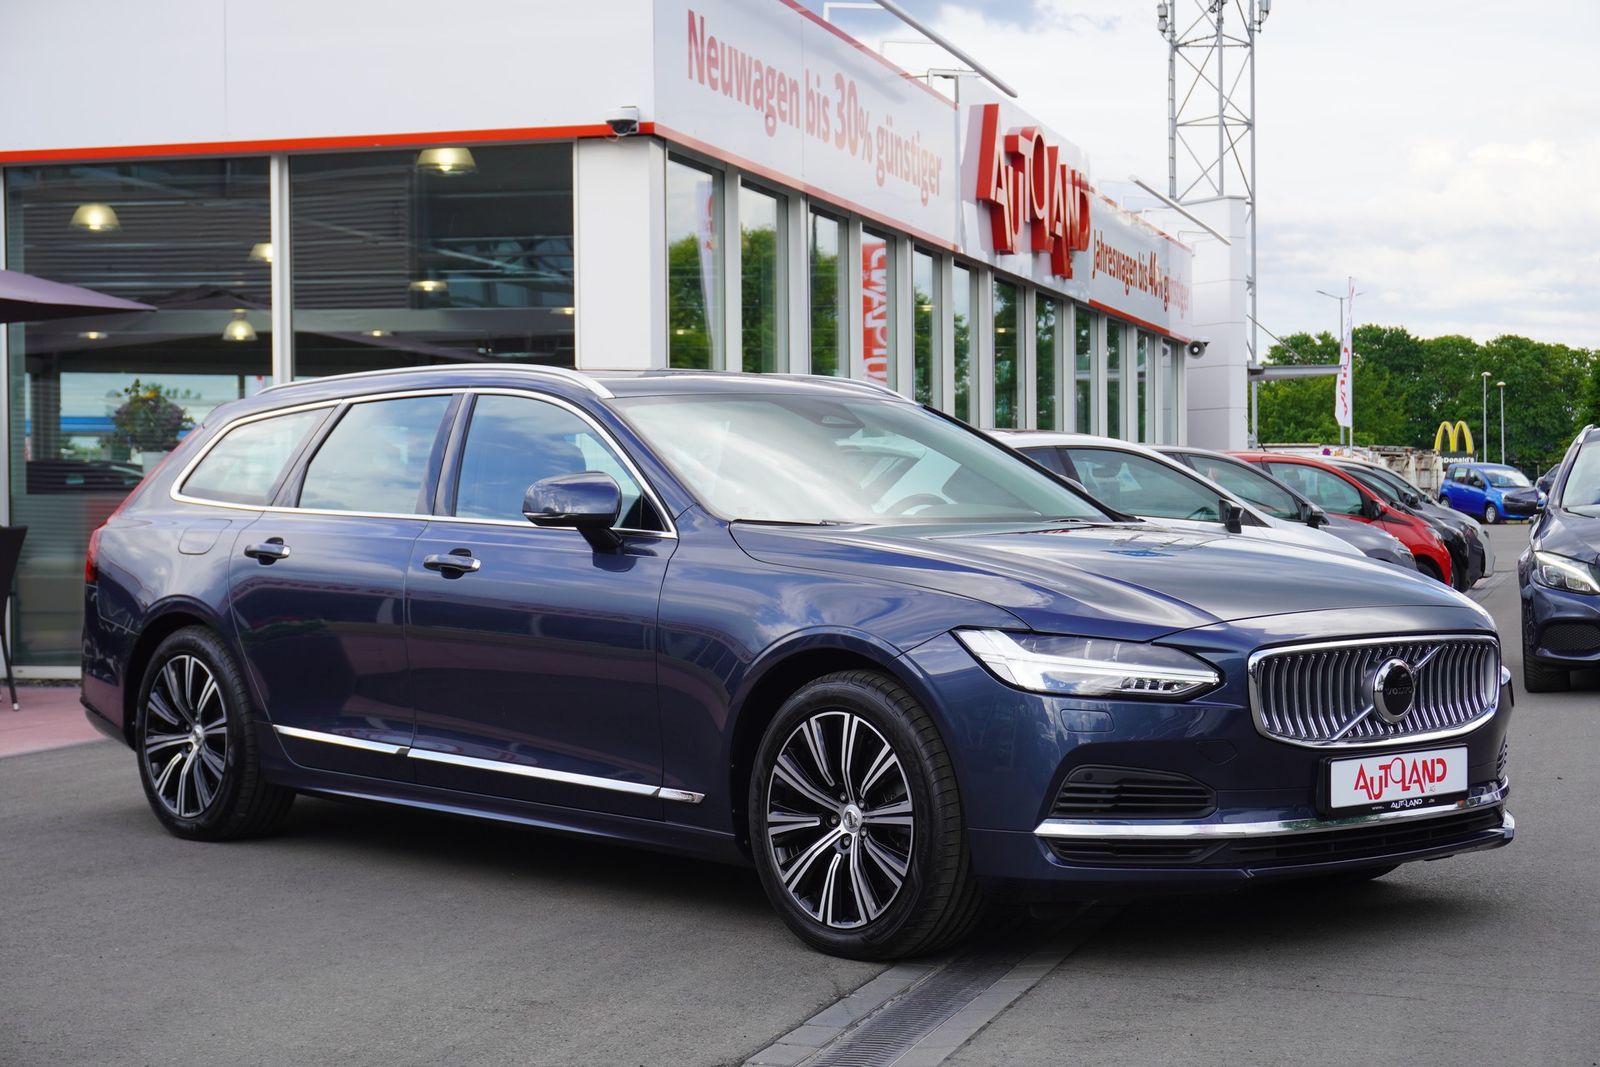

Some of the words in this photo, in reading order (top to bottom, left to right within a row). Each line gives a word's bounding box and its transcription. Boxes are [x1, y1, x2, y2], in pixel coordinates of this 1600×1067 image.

[687, 8, 800, 138] Neuwagen
[804, 68, 831, 144] bis
[834, 72, 873, 164] 30%
[876, 115, 942, 207] günstiger
[1092, 229, 1138, 296] Jahreswagen
[1138, 250, 1148, 293] bis
[1354, 757, 1447, 800] AUTOLAND
